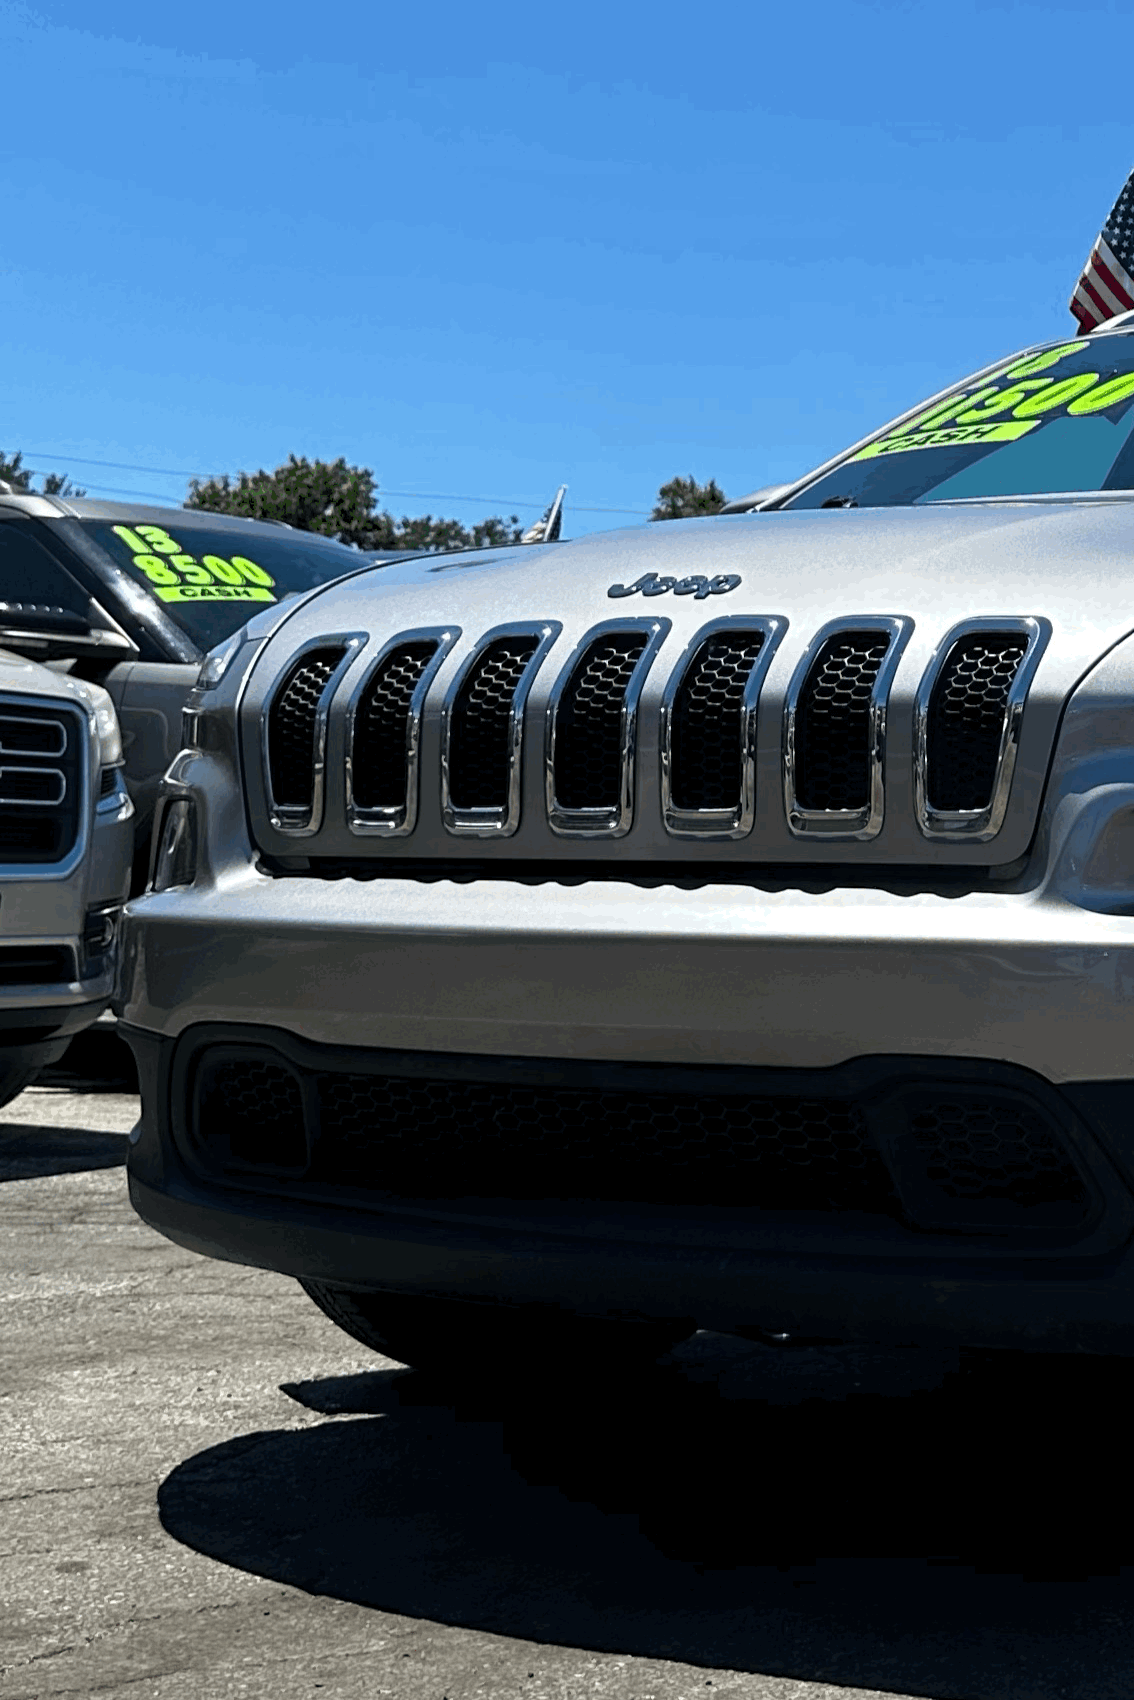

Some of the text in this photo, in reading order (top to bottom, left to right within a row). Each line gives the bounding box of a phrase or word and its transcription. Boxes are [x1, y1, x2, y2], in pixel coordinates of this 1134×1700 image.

[878, 425, 1003, 452] CASH
[112, 525, 182, 554] 13
[132, 554, 276, 588] 8500
[179, 588, 253, 598] CASH
[607, 572, 742, 600] Jeep
